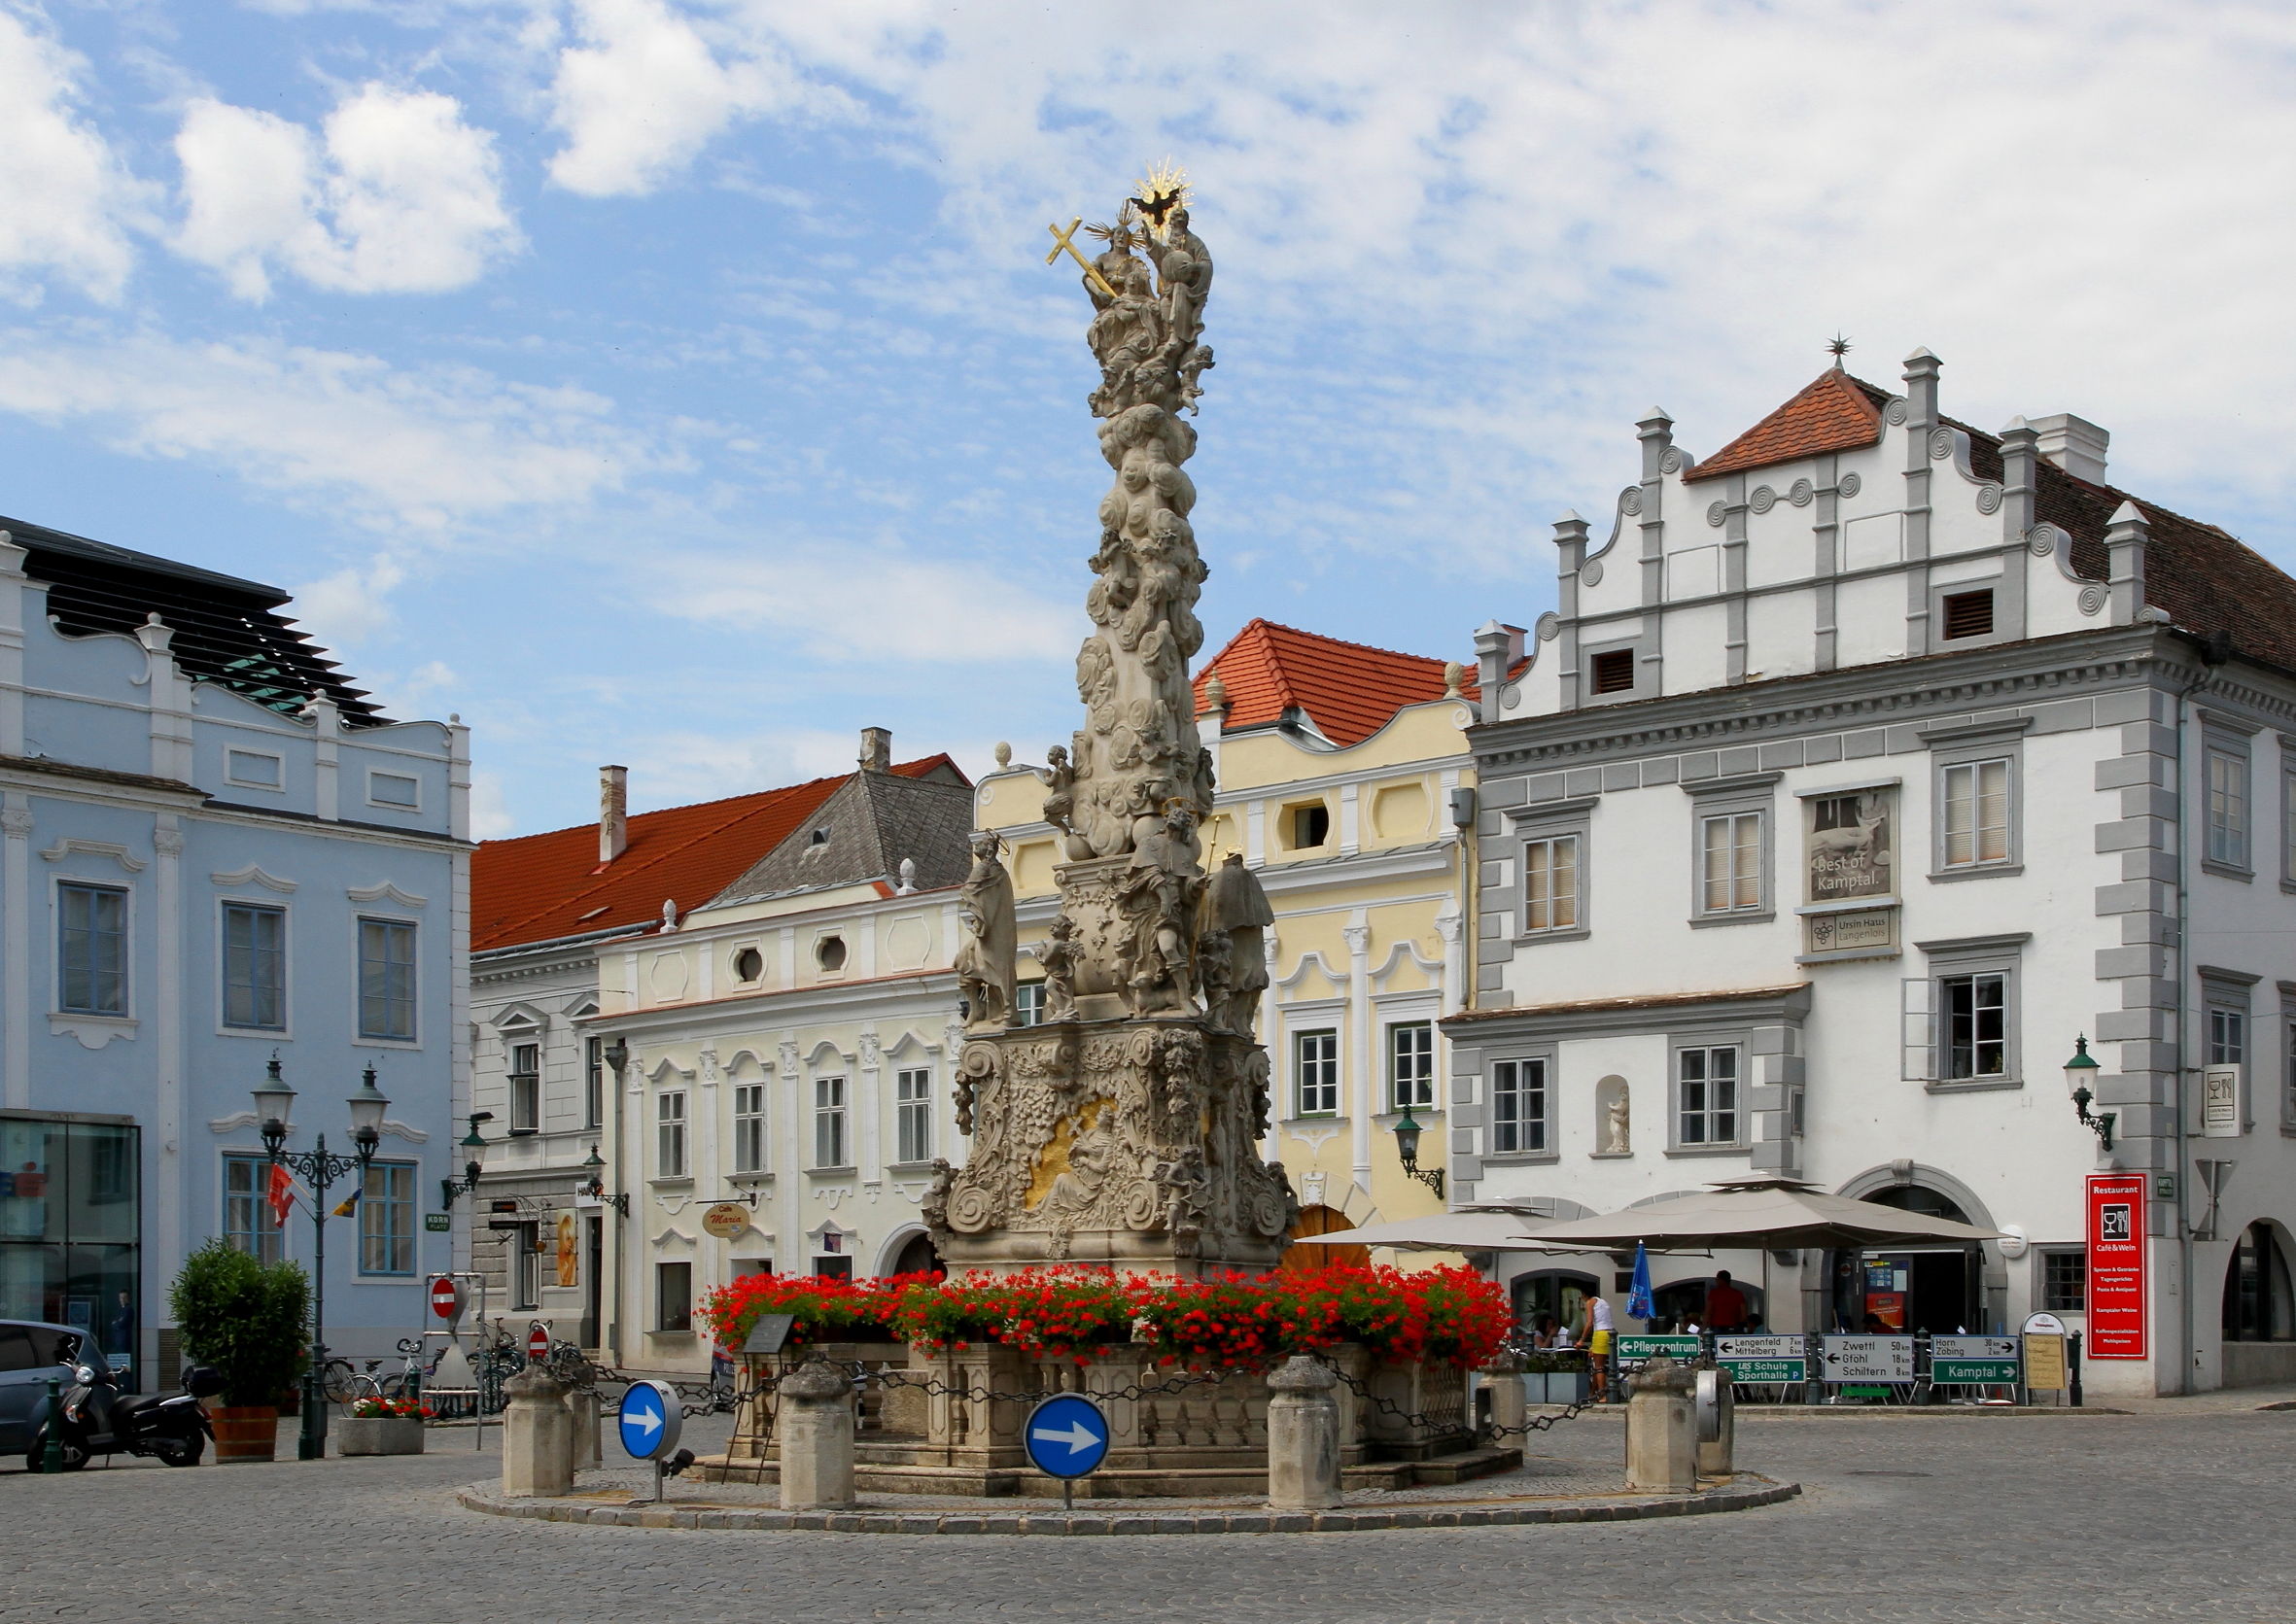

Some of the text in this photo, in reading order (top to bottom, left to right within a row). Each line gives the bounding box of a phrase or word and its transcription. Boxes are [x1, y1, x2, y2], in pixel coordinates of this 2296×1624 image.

[1818, 853, 1865, 872] Best of
[1818, 871, 1879, 891] Kamptal.
[1839, 918, 1885, 930] Ursin Haus
[1839, 928, 1885, 942] Langenlois
[2093, 1186, 2139, 1194] Restaurant
[711, 1214, 742, 1224] Maria
[1735, 1337, 1781, 1348] Lengenfeld
[1842, 1340, 1875, 1351] Zwettl
[1891, 1341, 1900, 1351] 50
[1735, 1347, 1777, 1356] Mittelberg
[1935, 1347, 1965, 1357] Zöbing
[1842, 1353, 1868, 1364] Gföhl
[1892, 1354, 1900, 1364] 18
[1755, 1362, 1788, 1370] Schule
[1842, 1366, 1887, 1376] Schiltern
[1896, 1366, 1900, 1376] 8
[1737, 1371, 1788, 1380] Sporthalle
[1948, 1365, 1997, 1379] Kamptal
